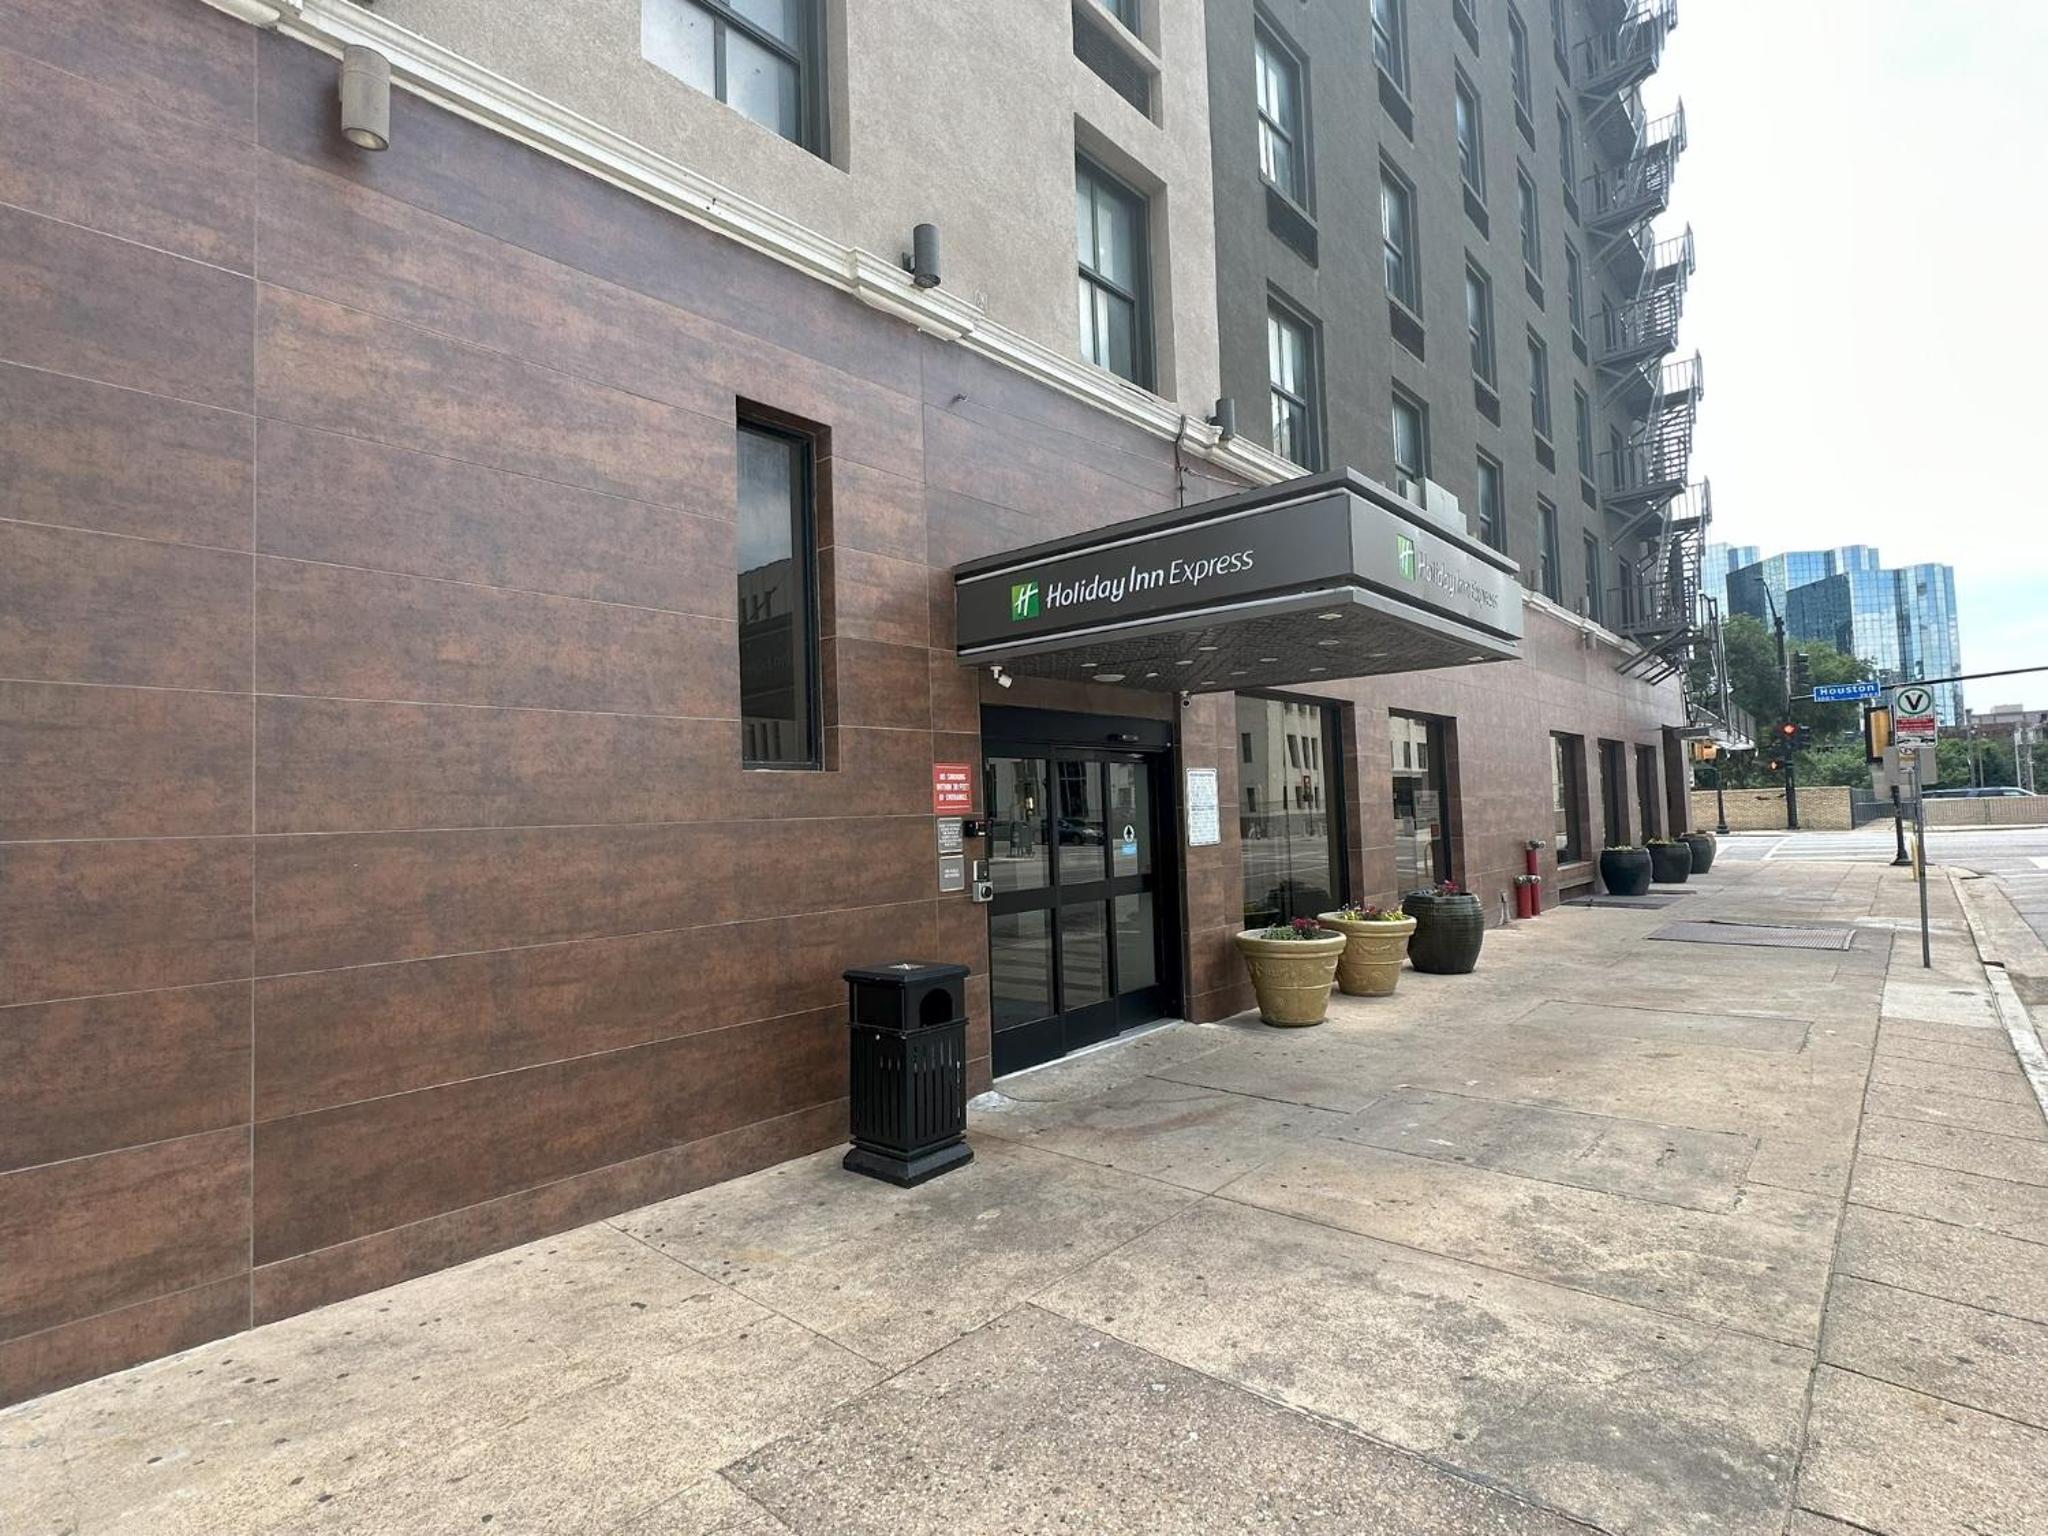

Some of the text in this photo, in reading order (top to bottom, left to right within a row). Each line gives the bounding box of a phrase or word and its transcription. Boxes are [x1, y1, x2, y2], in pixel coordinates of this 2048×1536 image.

[1046, 549, 1254, 609] Holiday Inn Express
[1418, 551, 1457, 598] Holiday
[1820, 684, 1875, 696] Houston
[1904, 693, 1924, 711] V
